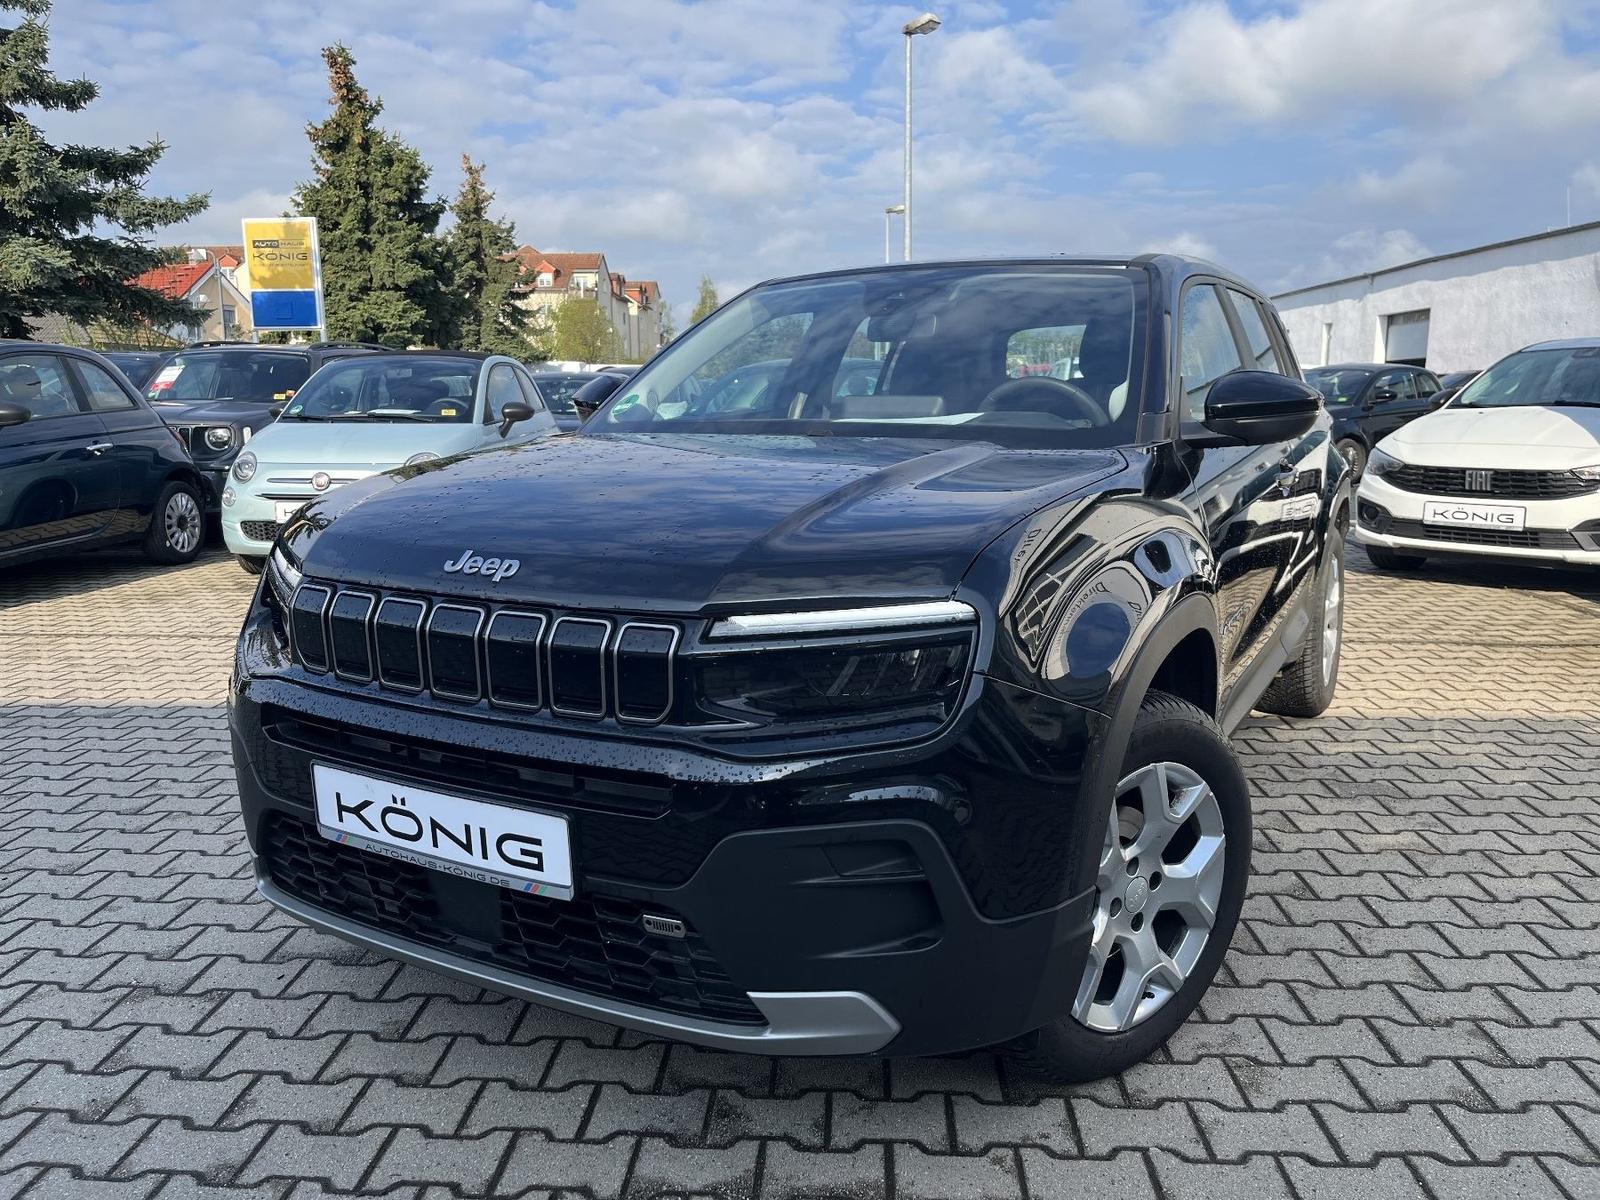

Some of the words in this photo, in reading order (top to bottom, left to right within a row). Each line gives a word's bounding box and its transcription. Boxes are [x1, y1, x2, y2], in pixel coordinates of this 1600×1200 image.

[252, 250, 308, 261] KÖNIG
[1465, 470, 1494, 491] FIAT
[1433, 507, 1515, 524] KÖNIG
[443, 549, 521, 582] Jeep
[335, 791, 545, 873] KÖNIG
